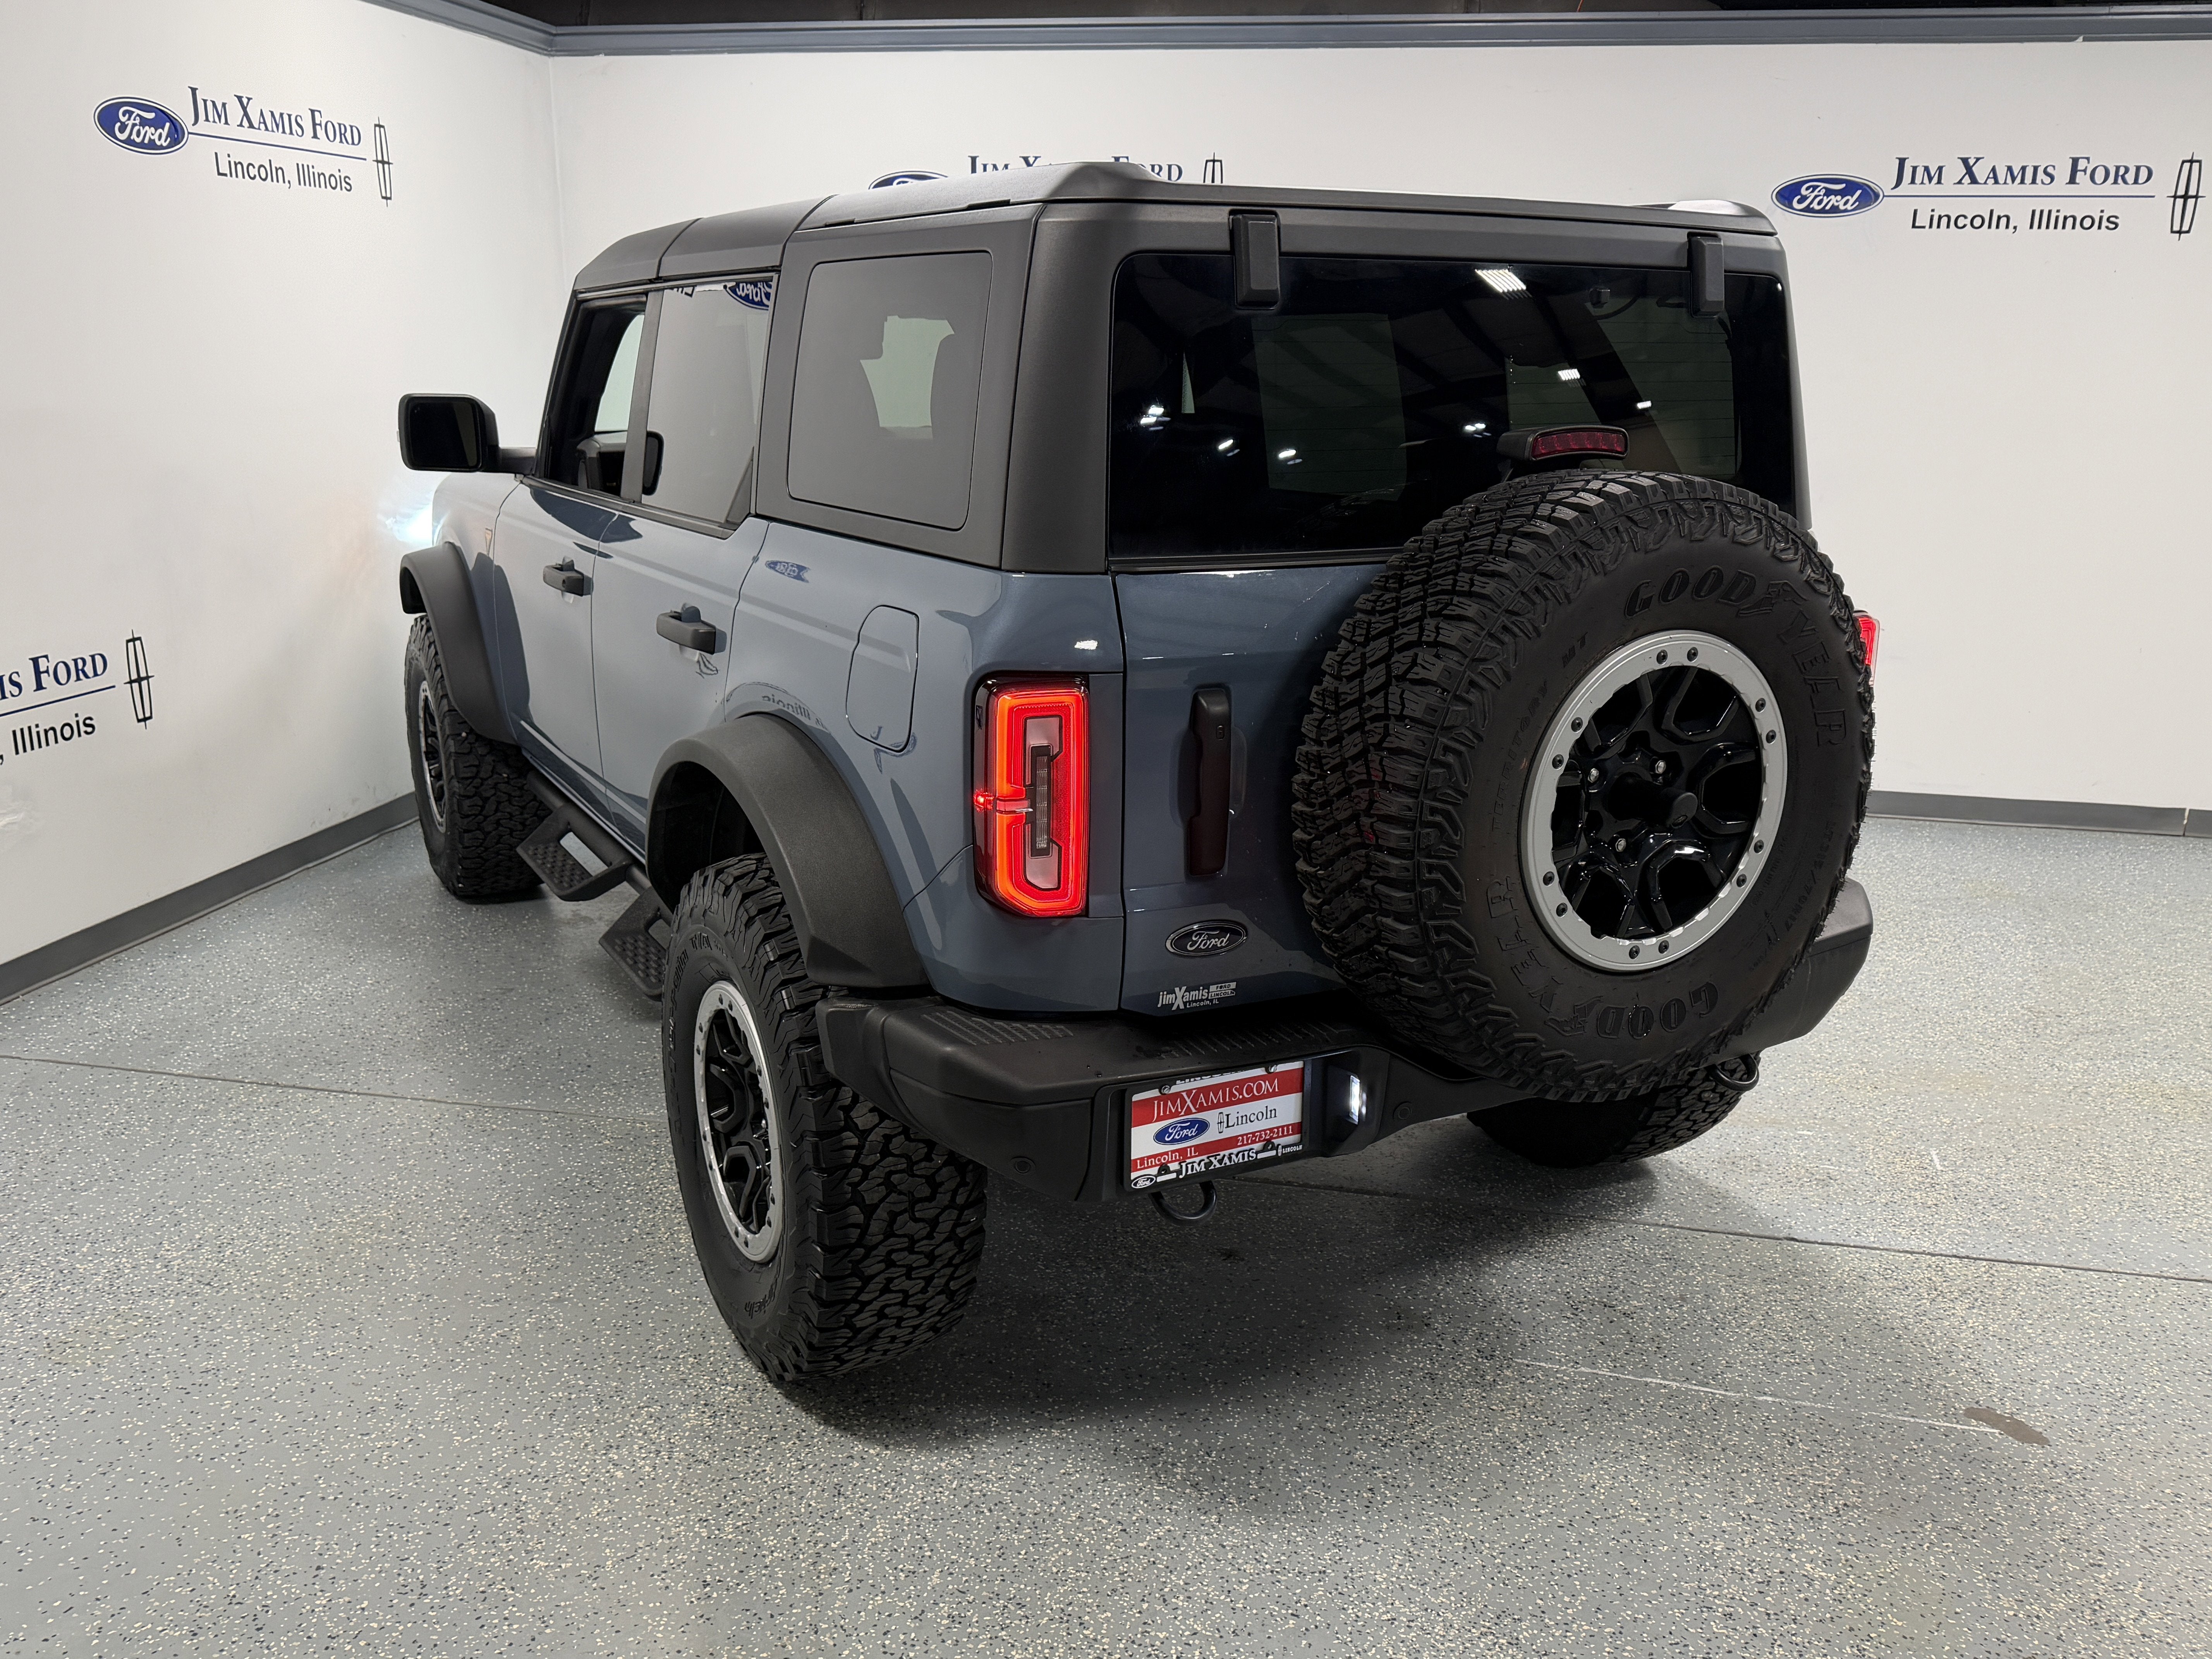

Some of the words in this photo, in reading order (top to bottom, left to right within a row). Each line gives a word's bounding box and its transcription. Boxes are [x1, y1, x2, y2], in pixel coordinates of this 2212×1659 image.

[115, 106, 171, 147] Ford
[188, 86, 230, 126] JIM
[234, 94, 304, 137] XAMIS
[308, 108, 362, 146] FORD
[215, 152, 291, 189] Lincoln,
[296, 163, 352, 192] Illinois
[1891, 157, 1946, 190] JIM
[1953, 156, 2056, 185] XAMIS
[2065, 156, 2154, 185] FORD
[1793, 182, 1863, 211] Ford
[1911, 208, 2018, 234] Lincoln,
[2029, 209, 2119, 230] Illinois
[29, 653, 108, 692] FORD
[12, 713, 96, 755] Illinois
[1187, 930, 1231, 951] Ford
[1152, 1078, 1279, 1123] JIMXAMIS.COM
[1165, 1122, 1199, 1141] Ford
[1225, 1106, 1277, 1128] Lincoln
[1237, 1125, 1293, 1146] 217-732-2111
[1137, 1152, 1183, 1169] Lincoln,
[1187, 1147, 1198, 1157] IL
[1179, 1161, 1206, 1178] JIM
[1209, 1149, 1256, 1170] XAMIS
[1282, 1144, 1303, 1154] LINCOLN
[1137, 1178, 1151, 1187] Ford
